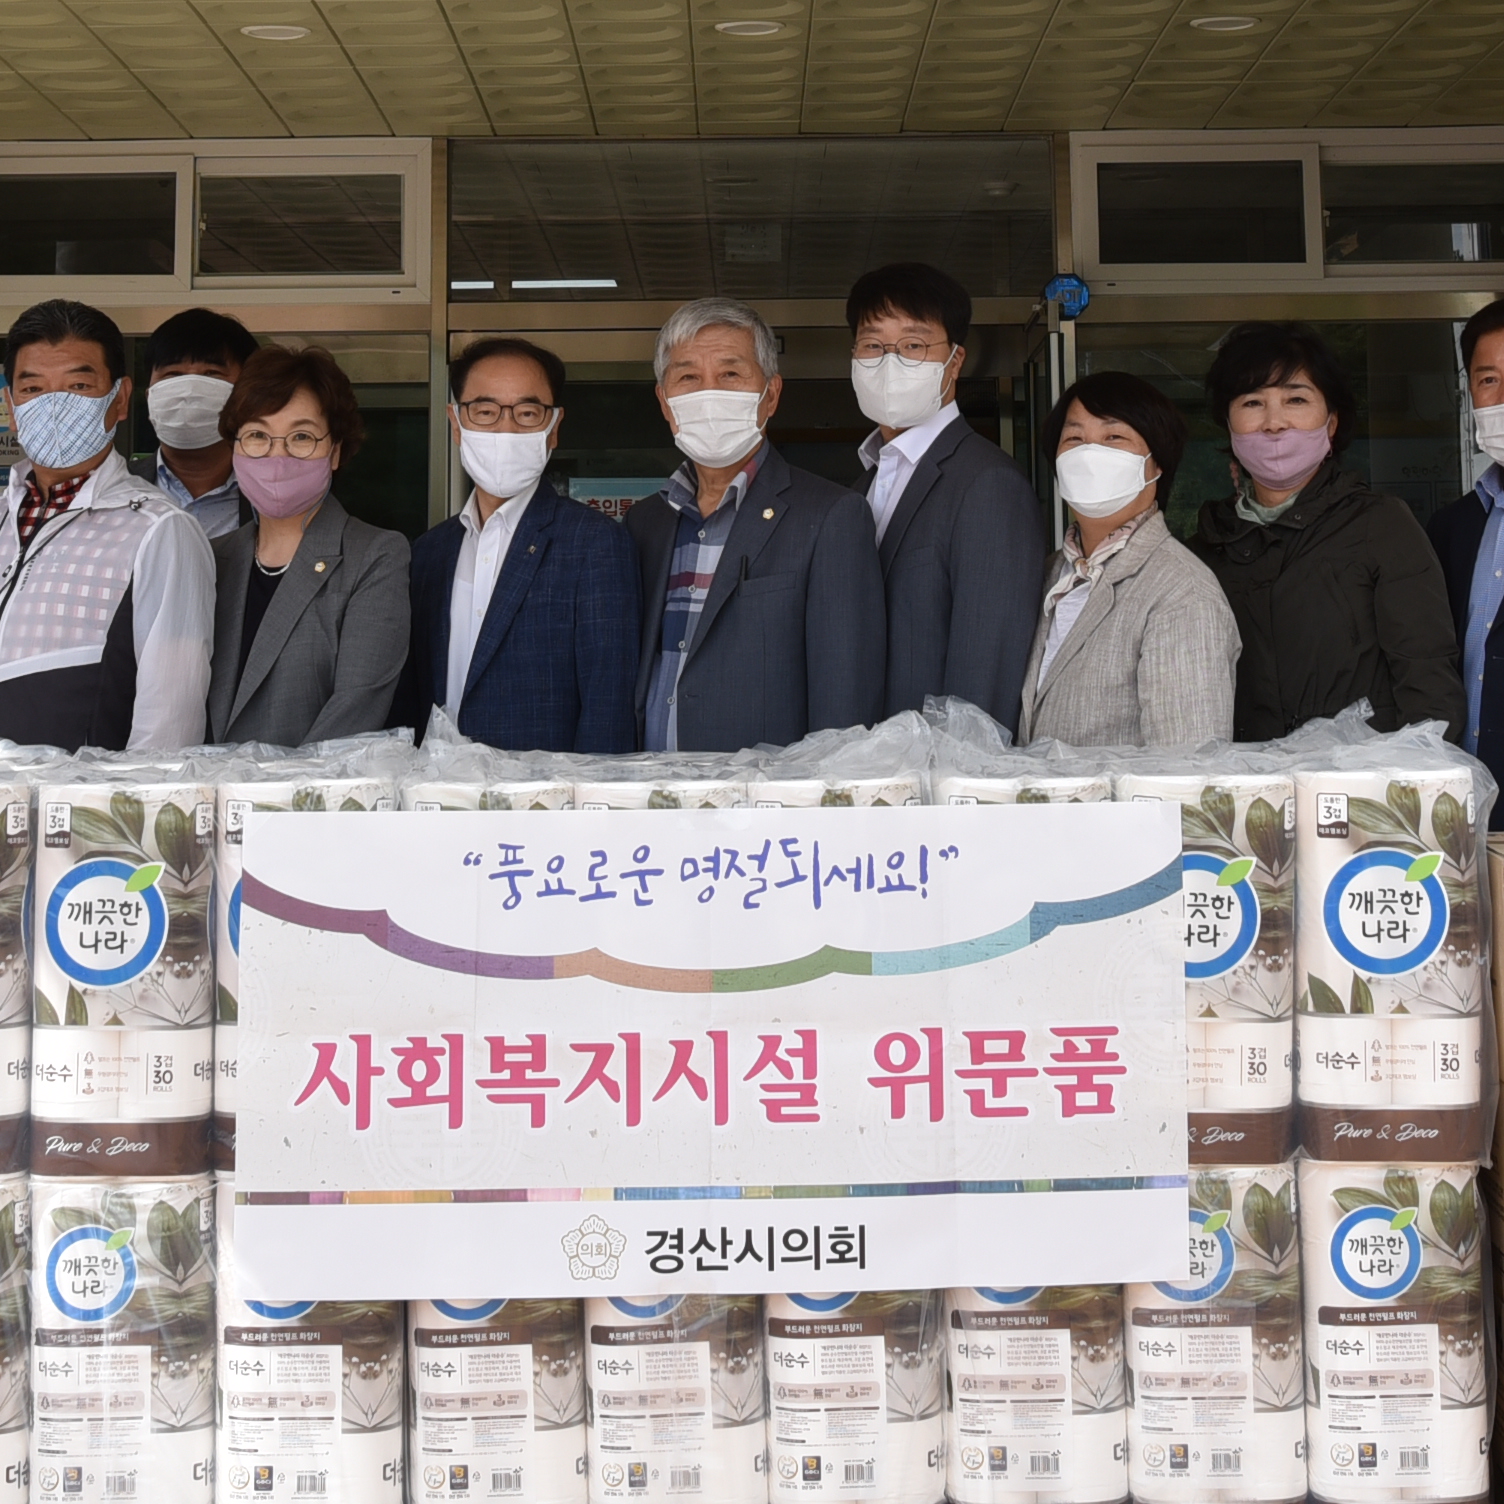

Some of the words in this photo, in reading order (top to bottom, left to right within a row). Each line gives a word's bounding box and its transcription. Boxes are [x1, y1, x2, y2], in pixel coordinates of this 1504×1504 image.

[587, 498, 642, 517] 입통
[49, 815, 66, 829] 3겹
[1323, 806, 1342, 820] 3겹
[1182, 892, 1235, 919] 끗한
[1348, 888, 1424, 916] 깨끗한
[67, 899, 143, 926] 깨끗한
[1361, 920, 1410, 944] 나라
[79, 930, 128, 955] 나라
[1247, 1047, 1267, 1060] 3겹
[1440, 1043, 1459, 1056] 3겹
[153, 1055, 173, 1068] 3겹
[1247, 1061, 1267, 1076] 30
[1316, 1051, 1361, 1070] 더순수
[1440, 1057, 1460, 1072] 30
[35, 1063, 73, 1083] 더순수
[152, 1070, 174, 1085] 30
[295, 1029, 821, 1130] 사회복지시설
[868, 1026, 1127, 1123] 위문품
[1201, 1127, 1245, 1145] Deco
[1333, 1122, 1373, 1142] Pure
[1376, 1124, 1392, 1139] &
[1395, 1122, 1440, 1142] Deco
[45, 1136, 83, 1156] Pure
[86, 1138, 103, 1153] &
[106, 1136, 150, 1156] Deco
[580, 1241, 607, 1259] 의회
[645, 1224, 866, 1274] 경산시의회
[1348, 1234, 1404, 1256] 깨끗한
[62, 1255, 119, 1277] 깨끗한
[1190, 1260, 1208, 1278] 라
[1358, 1258, 1395, 1277] 나라
[71, 1280, 107, 1298] 나라
[971, 1317, 998, 1326] 부드러운
[999, 1316, 1027, 1326] 천연펄프
[1028, 1316, 1049, 1325] 화장지
[1339, 1313, 1367, 1322] 부드러운
[1368, 1312, 1395, 1321] 천연펄프
[1396, 1311, 1417, 1321] 화장지
[241, 1332, 269, 1342] 부드러운
[270, 1332, 298, 1341] 천연펄프
[299, 1332, 321, 1341] 화장지
[431, 1334, 459, 1343] 부드러운
[460, 1333, 488, 1342] 천연펄프
[489, 1332, 510, 1341] 화장지
[784, 1324, 812, 1334] 부드러운
[813, 1324, 841, 1333] 천연펄프
[842, 1323, 863, 1332] 화장지
[958, 1343, 996, 1360] 더순수
[1139, 1341, 1177, 1357] 더순수
[1326, 1339, 1365, 1356] 더순수
[229, 1359, 266, 1377] 더순수
[597, 1359, 634, 1376] 더순수
[774, 1351, 810, 1369] 더순수
[38, 1361, 74, 1378] 더순수
[420, 1361, 457, 1378] 더순수
